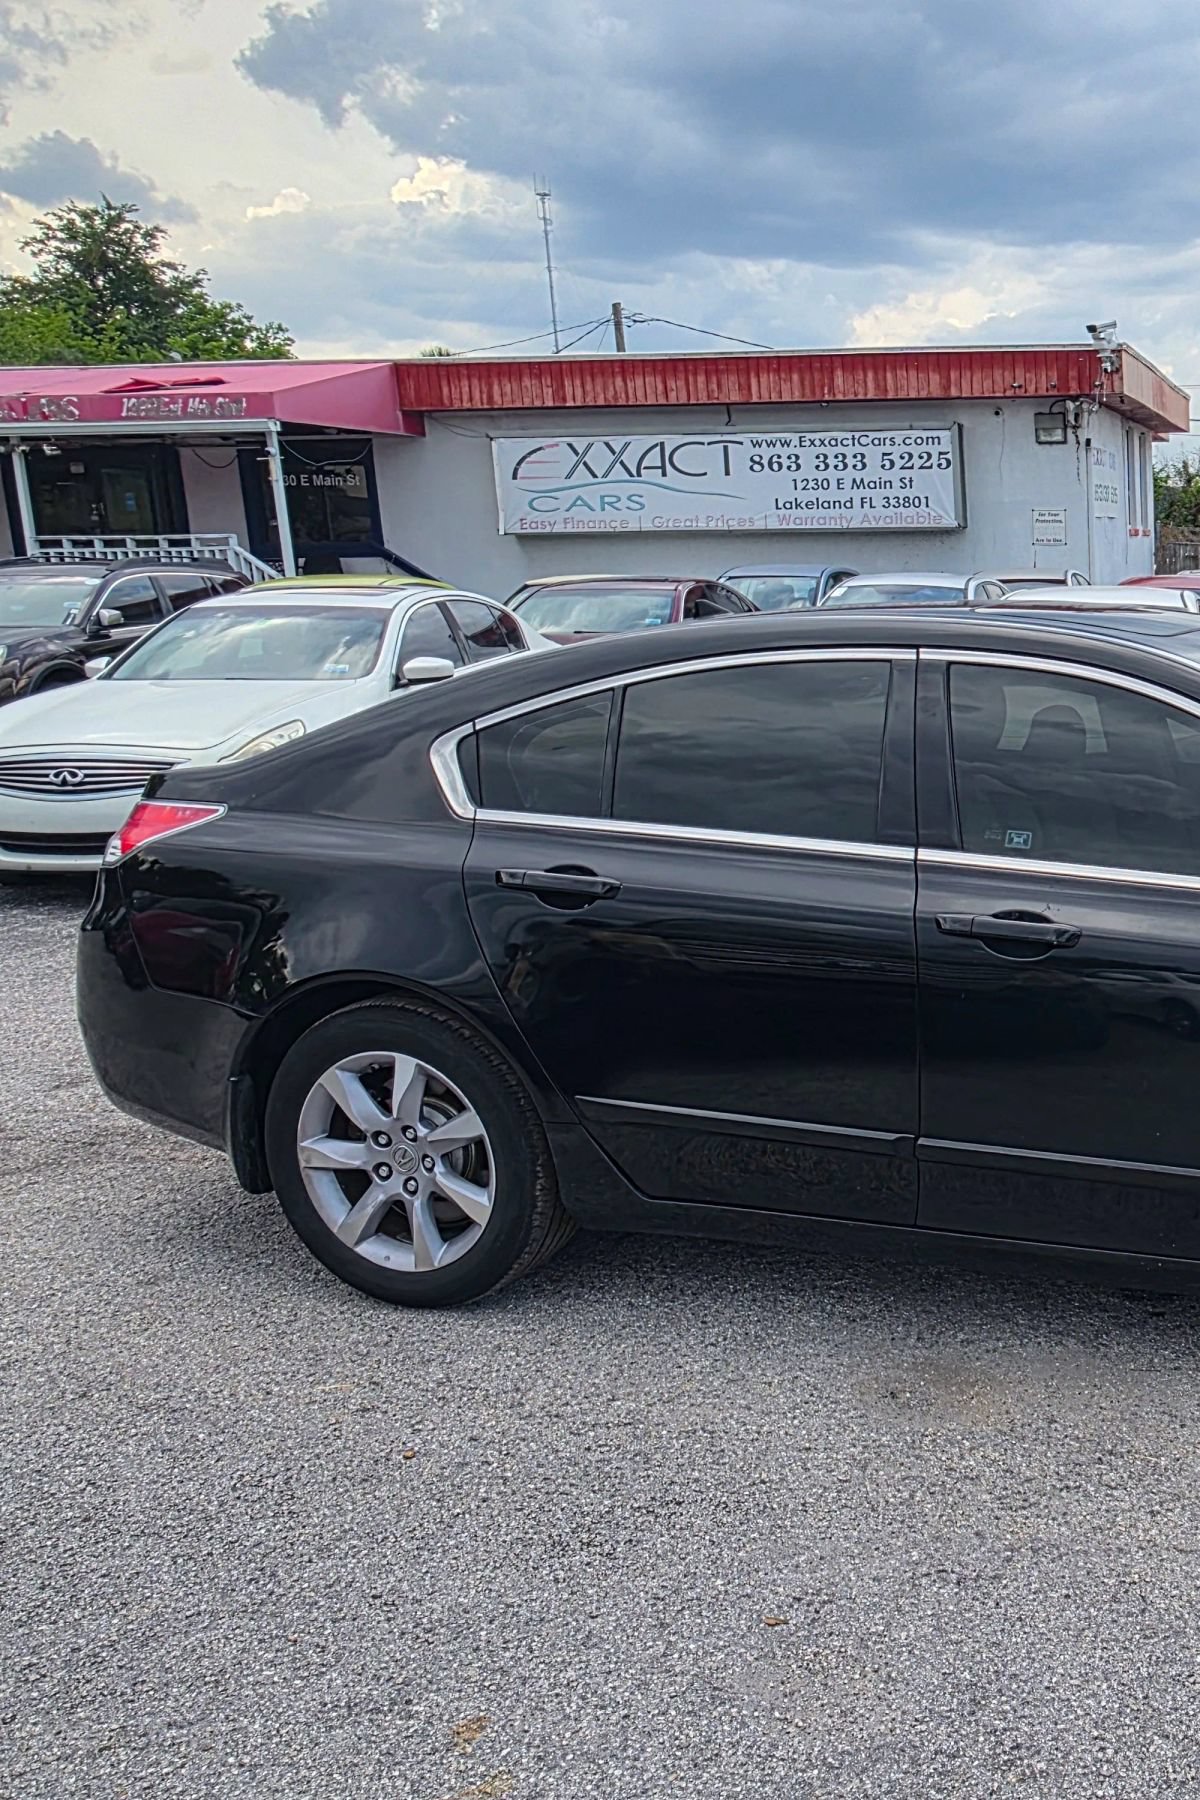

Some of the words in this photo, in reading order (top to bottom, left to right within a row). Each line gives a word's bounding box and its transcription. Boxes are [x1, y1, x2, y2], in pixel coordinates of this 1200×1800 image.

[750, 434, 941, 449] www.ExxactCars.com
[511, 440, 744, 481] EXXACT
[749, 453, 802, 473] 863
[814, 452, 868, 472] 333
[880, 450, 952, 471] 5225
[300, 475, 310, 486] E
[312, 474, 343, 487] Main
[346, 474, 360, 486] St
[791, 478, 831, 491] 1230
[836, 478, 845, 490] E
[850, 477, 893, 490] Main
[899, 476, 914, 490] St
[527, 493, 646, 513] CARS
[775, 497, 854, 510] Lakeland
[860, 496, 877, 509] FL
[882, 495, 930, 509] 33801
[519, 517, 558, 532] Easy
[563, 517, 630, 530] Finance
[651, 515, 700, 529] Great
[705, 514, 756, 529] Prices
[777, 513, 854, 529] Warranty
[860, 511, 944, 526] Available
